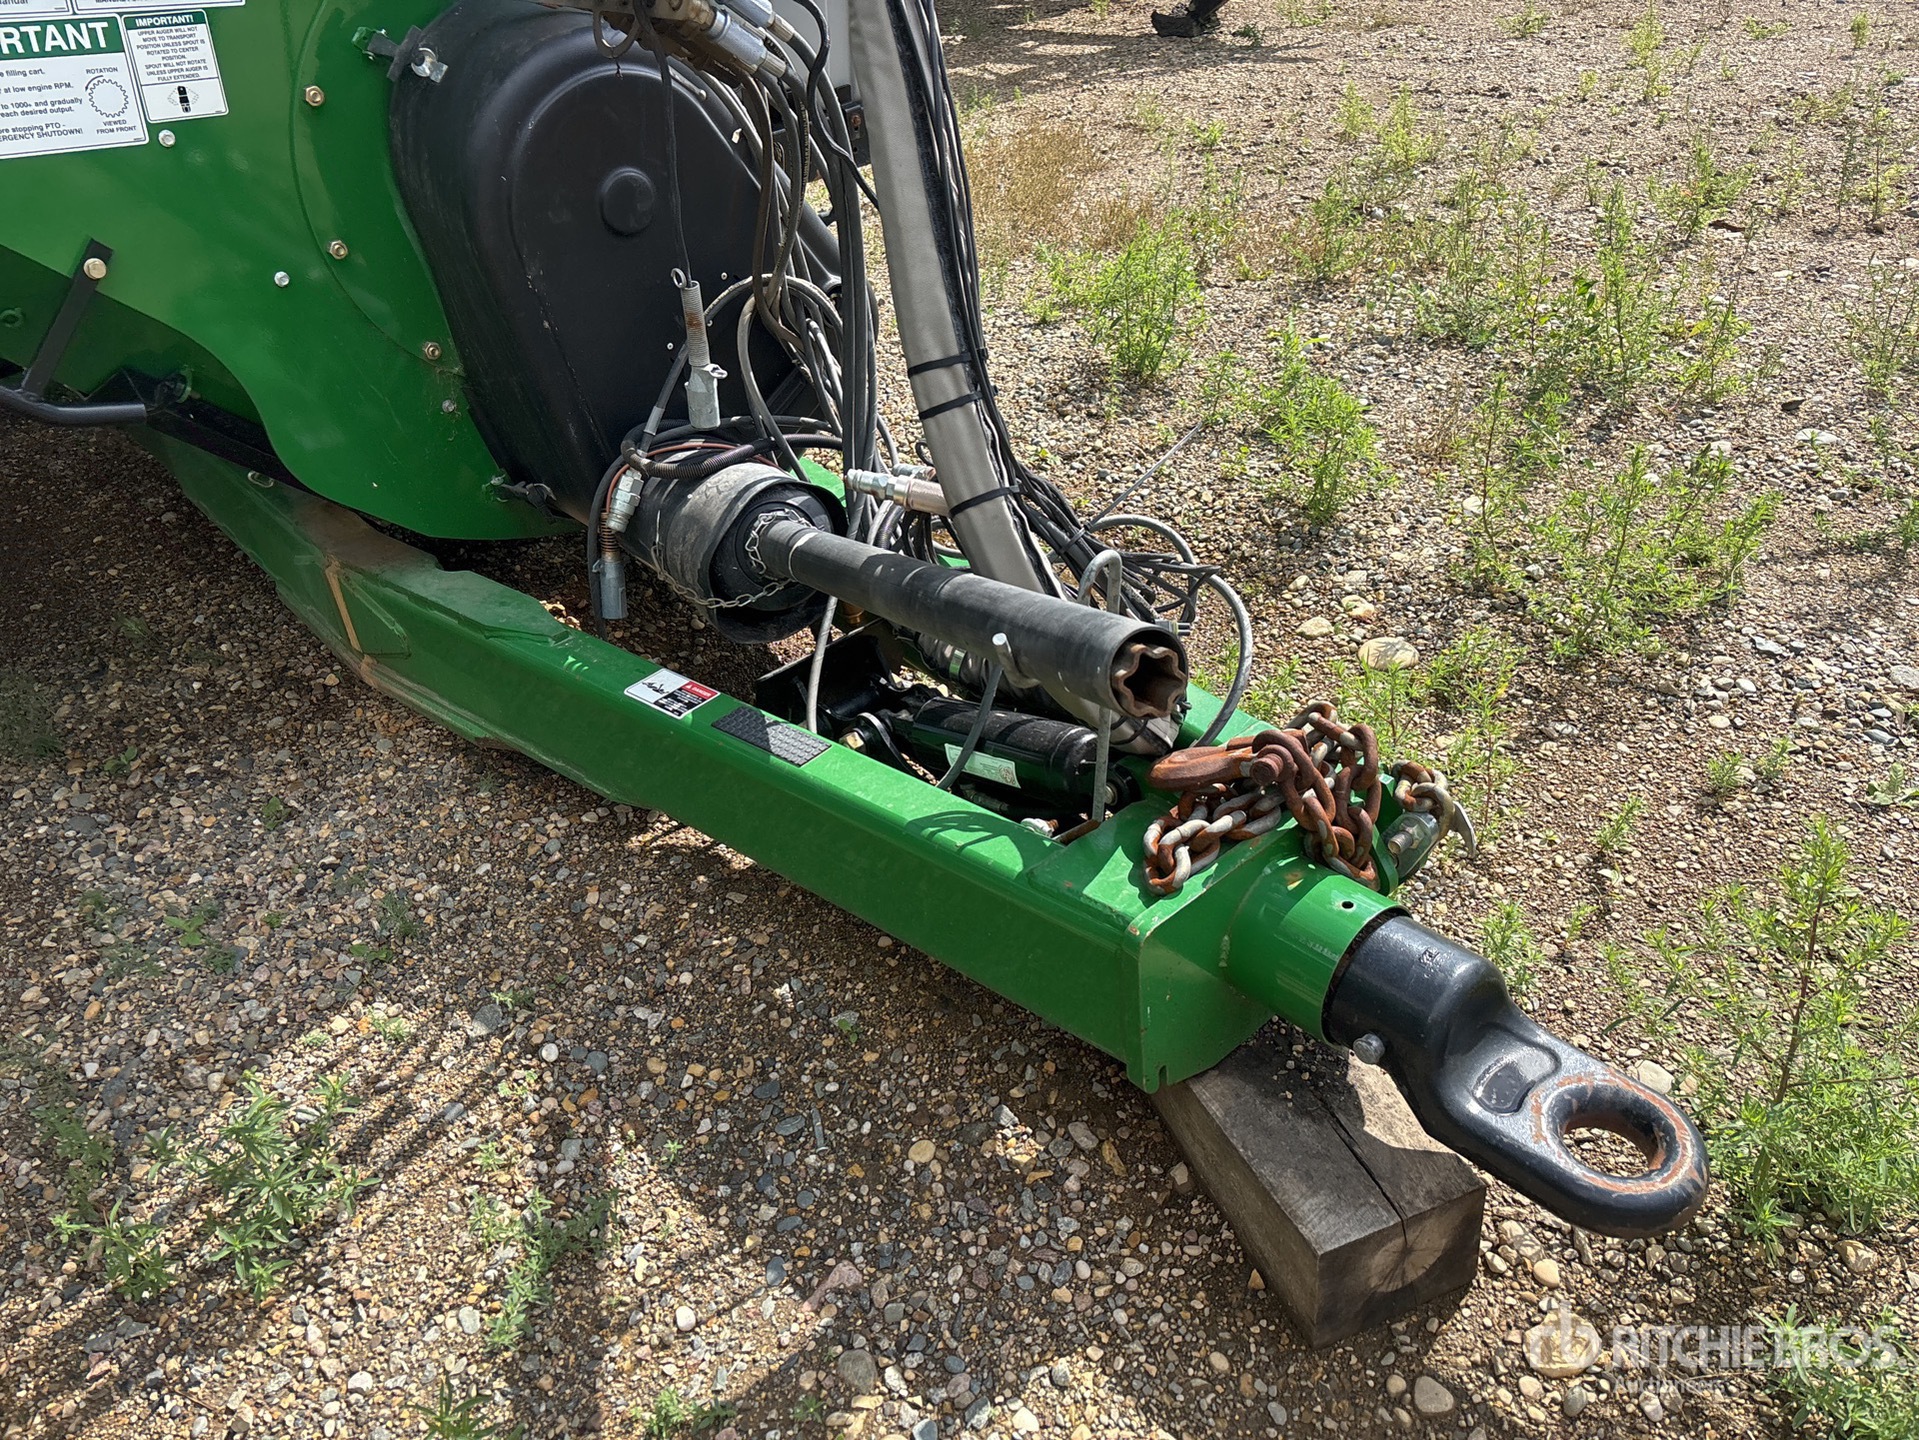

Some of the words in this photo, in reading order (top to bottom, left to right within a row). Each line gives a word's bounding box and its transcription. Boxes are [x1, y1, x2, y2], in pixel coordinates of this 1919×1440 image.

[135, 14, 194, 27] IMPORTANT!
[5, 69, 27, 78] filling
[85, 66, 119, 75] ROTATION
[27, 83, 53, 92] engine
[53, 81, 74, 89] RPM.
[50, 97, 83, 107] gradually
[20, 108, 48, 116] desired
[49, 105, 75, 114] output.
[11, 124, 44, 133] stopping
[44, 121, 61, 129] PTO
[102, 119, 127, 127] VIEWED
[36, 127, 84, 139] SHUTDOWN!
[116, 125, 137, 133] FRONT
